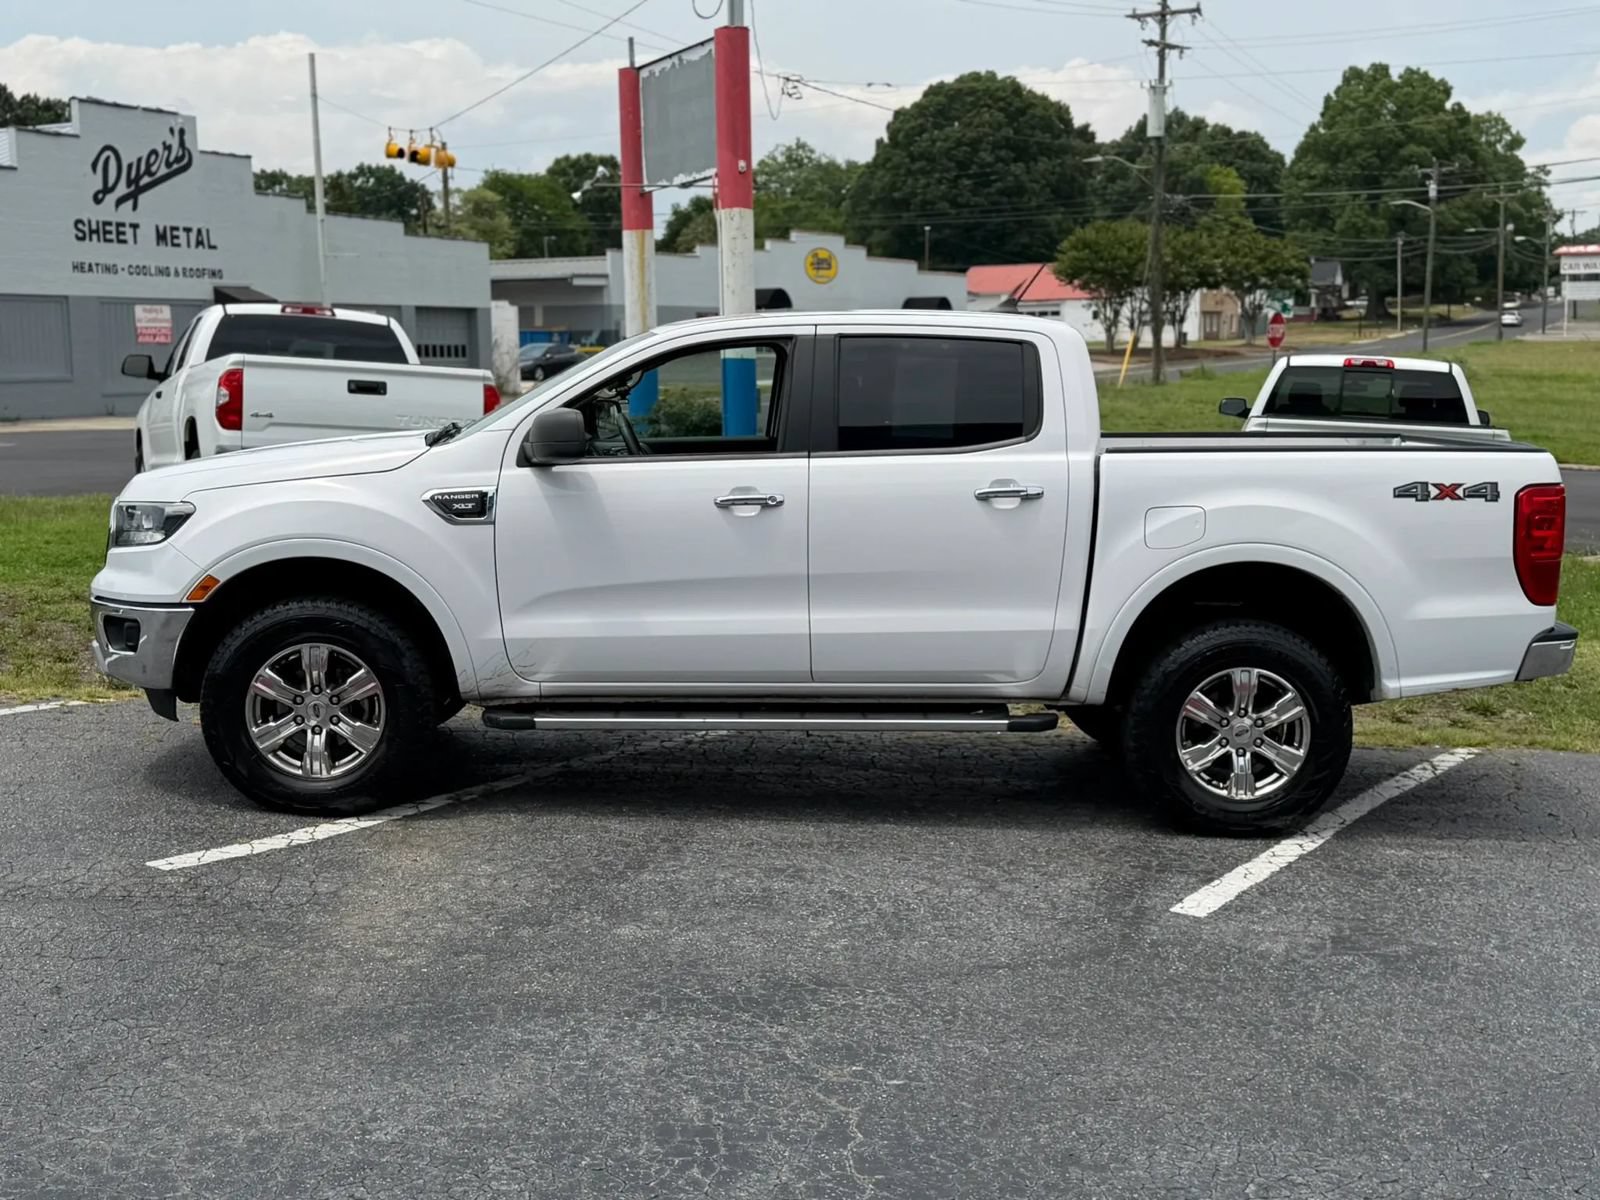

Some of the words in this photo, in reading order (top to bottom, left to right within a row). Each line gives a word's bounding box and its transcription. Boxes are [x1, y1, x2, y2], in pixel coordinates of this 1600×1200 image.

[91, 126, 193, 212] Dyer's
[73, 217, 141, 245] SHEET
[155, 224, 218, 250] METAL
[72, 261, 119, 275] HEATING
[127, 264, 172, 278] COOLING
[182, 267, 224, 280] ROOFING
[1563, 261, 1582, 270] CAR
[1268, 324, 1285, 338] STOP
[452, 502, 476, 510] XLT
